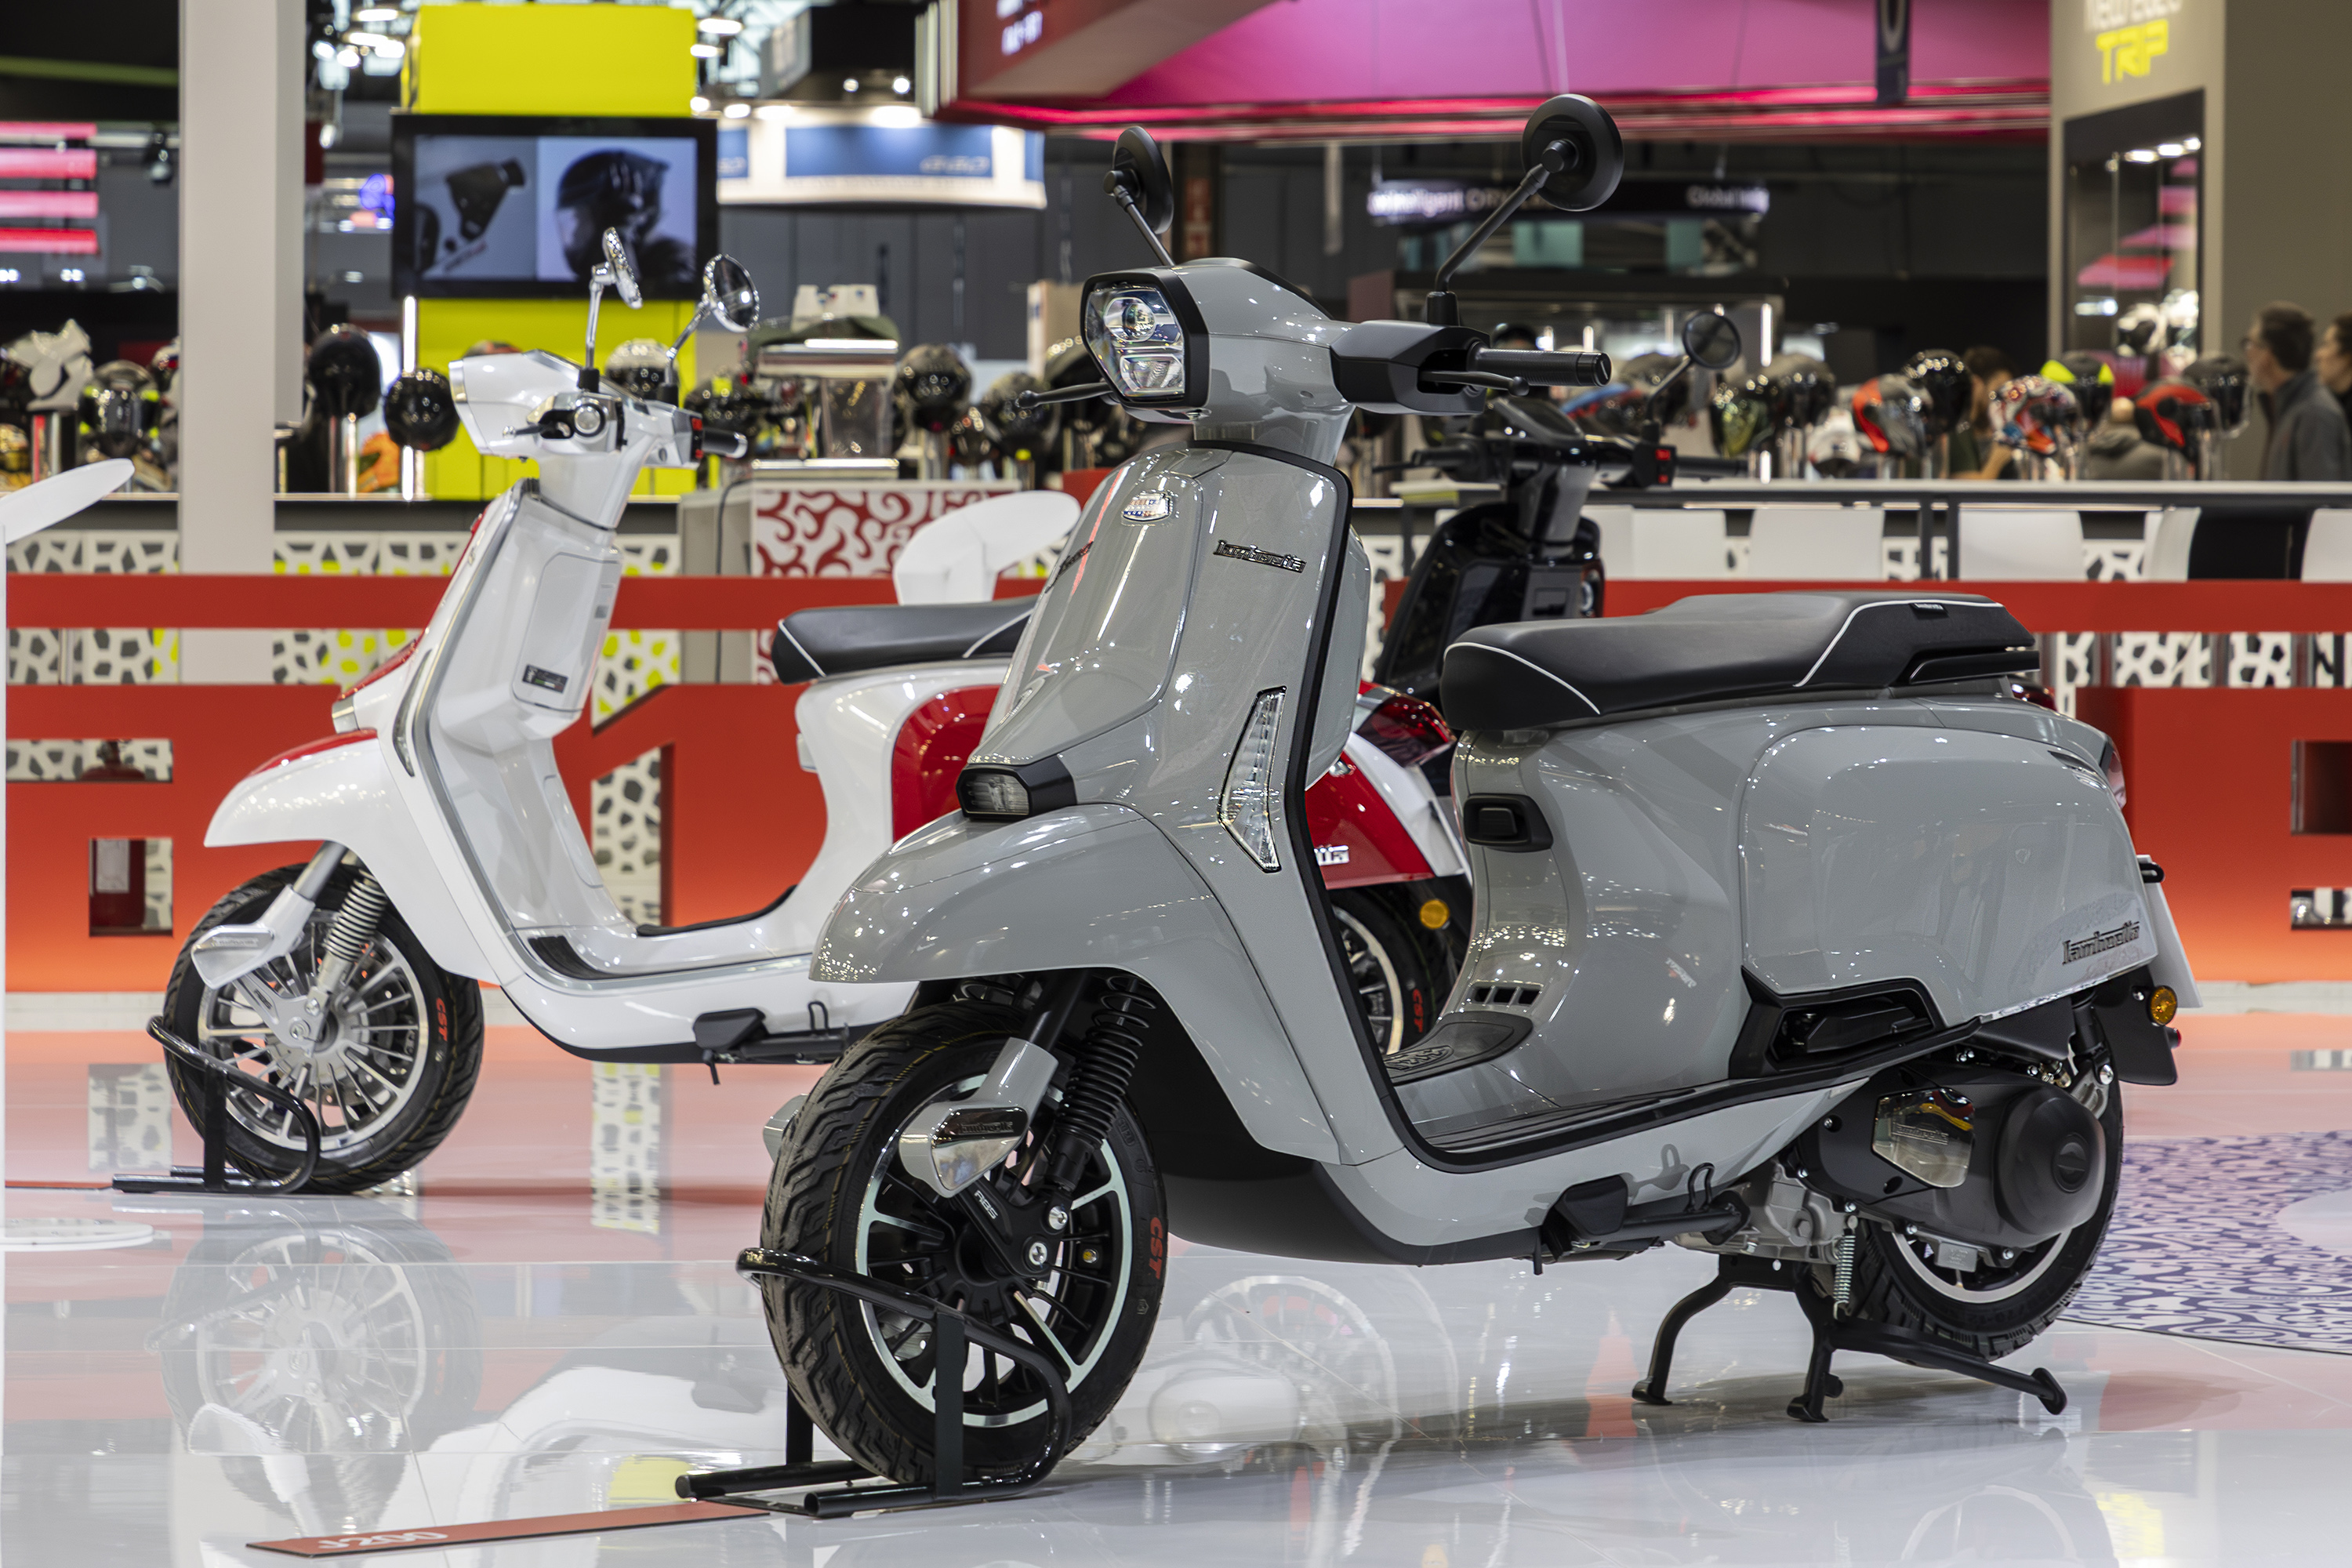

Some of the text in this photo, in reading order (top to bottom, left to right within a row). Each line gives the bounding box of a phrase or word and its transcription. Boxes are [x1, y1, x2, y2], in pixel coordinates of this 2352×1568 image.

[435, 996, 448, 1043] CST
[1412, 989, 1424, 1033] CST
[974, 1189, 999, 1220] ABS
[1148, 1216, 1164, 1280] CST
